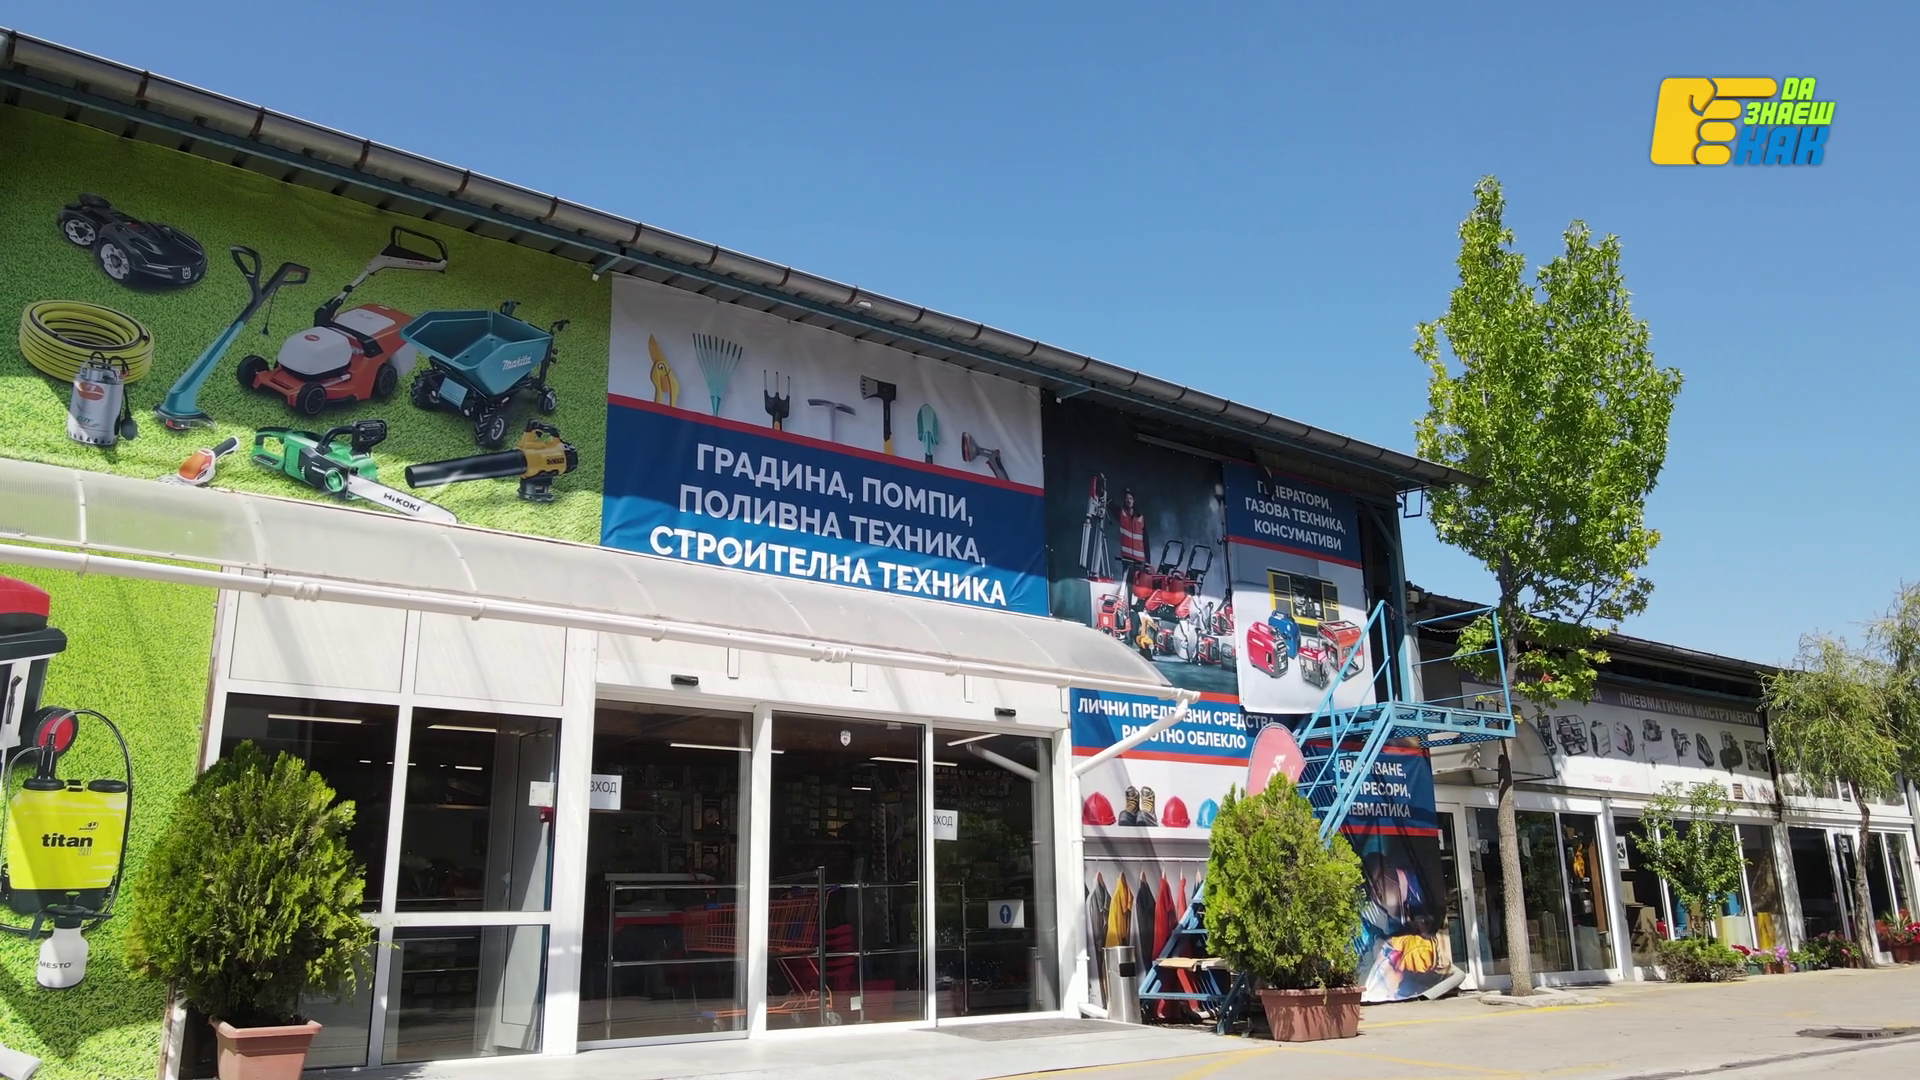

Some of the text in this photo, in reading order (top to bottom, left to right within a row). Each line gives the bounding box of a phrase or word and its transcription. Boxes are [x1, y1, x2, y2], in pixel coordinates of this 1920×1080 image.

[697, 443, 974, 527] ГРАДИНА, ПОМПИ,
[680, 484, 986, 568] ПОЛИВНА ТЕХНИКА,
[1245, 497, 1346, 535] ГАЗОВА ТЕХНИКА,
[1254, 519, 1342, 551] КОНСУМАТИВИ
[650, 526, 1007, 607] СТРОИТЕЛНА ТЕХНИКА
[1078, 698, 1130, 716] ЛИЧНИ
[1132, 703, 1212, 725] ПРЕДЗНИ
[1619, 692, 1693, 715] ПНЕВМАТИЧНИ
[1695, 706, 1760, 726] ИНСТРУМЕНТИ
[1121, 724, 1247, 749] РАОТНО ОБЛЕКЛО
[1348, 802, 1411, 818] ЕВМАТИКА
[42, 833, 93, 848] titan
[39, 961, 72, 969] MESTO
